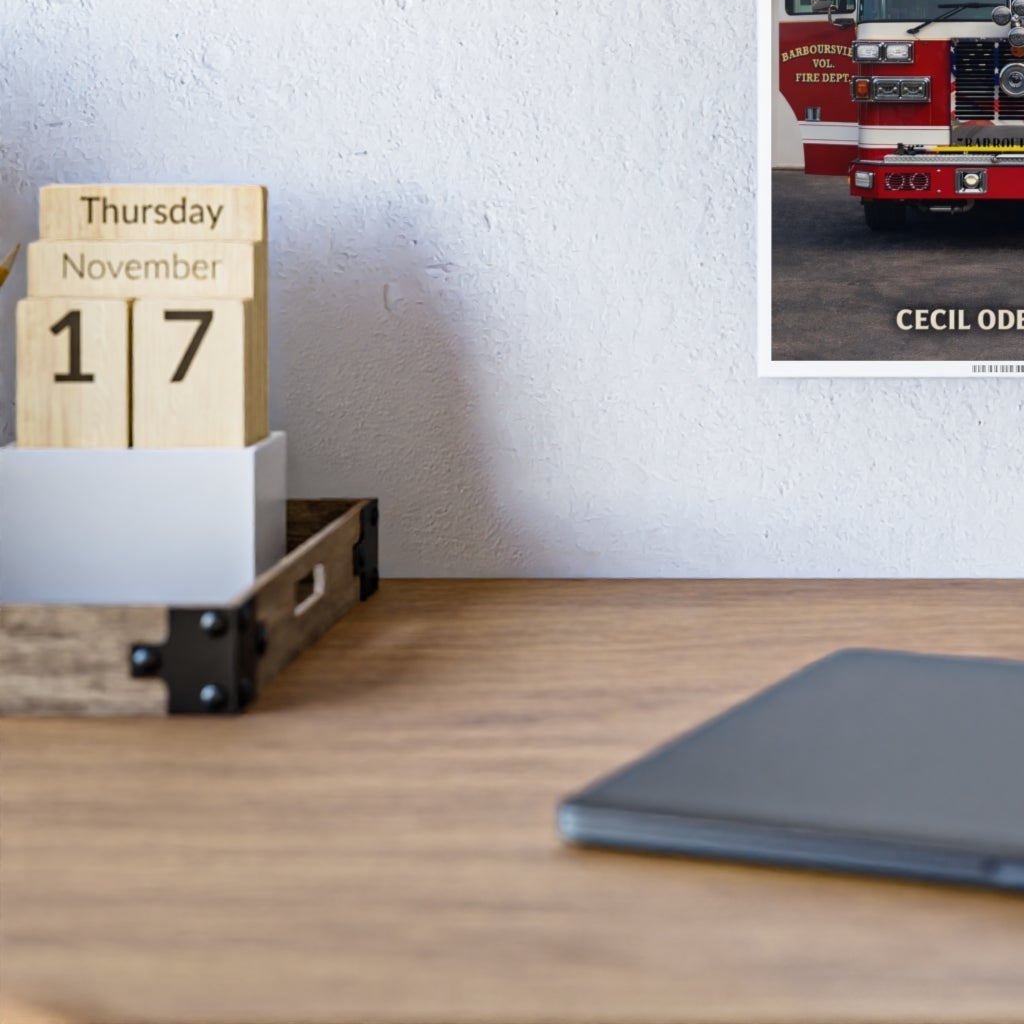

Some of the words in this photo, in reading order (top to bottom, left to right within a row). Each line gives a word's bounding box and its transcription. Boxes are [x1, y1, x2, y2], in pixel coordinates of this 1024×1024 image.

[812, 58, 835, 68] VOL.
[795, 72, 820, 83] FIRE
[80, 196, 224, 230] Thursday
[61, 252, 222, 281] November
[896, 308, 971, 331] CECIL
